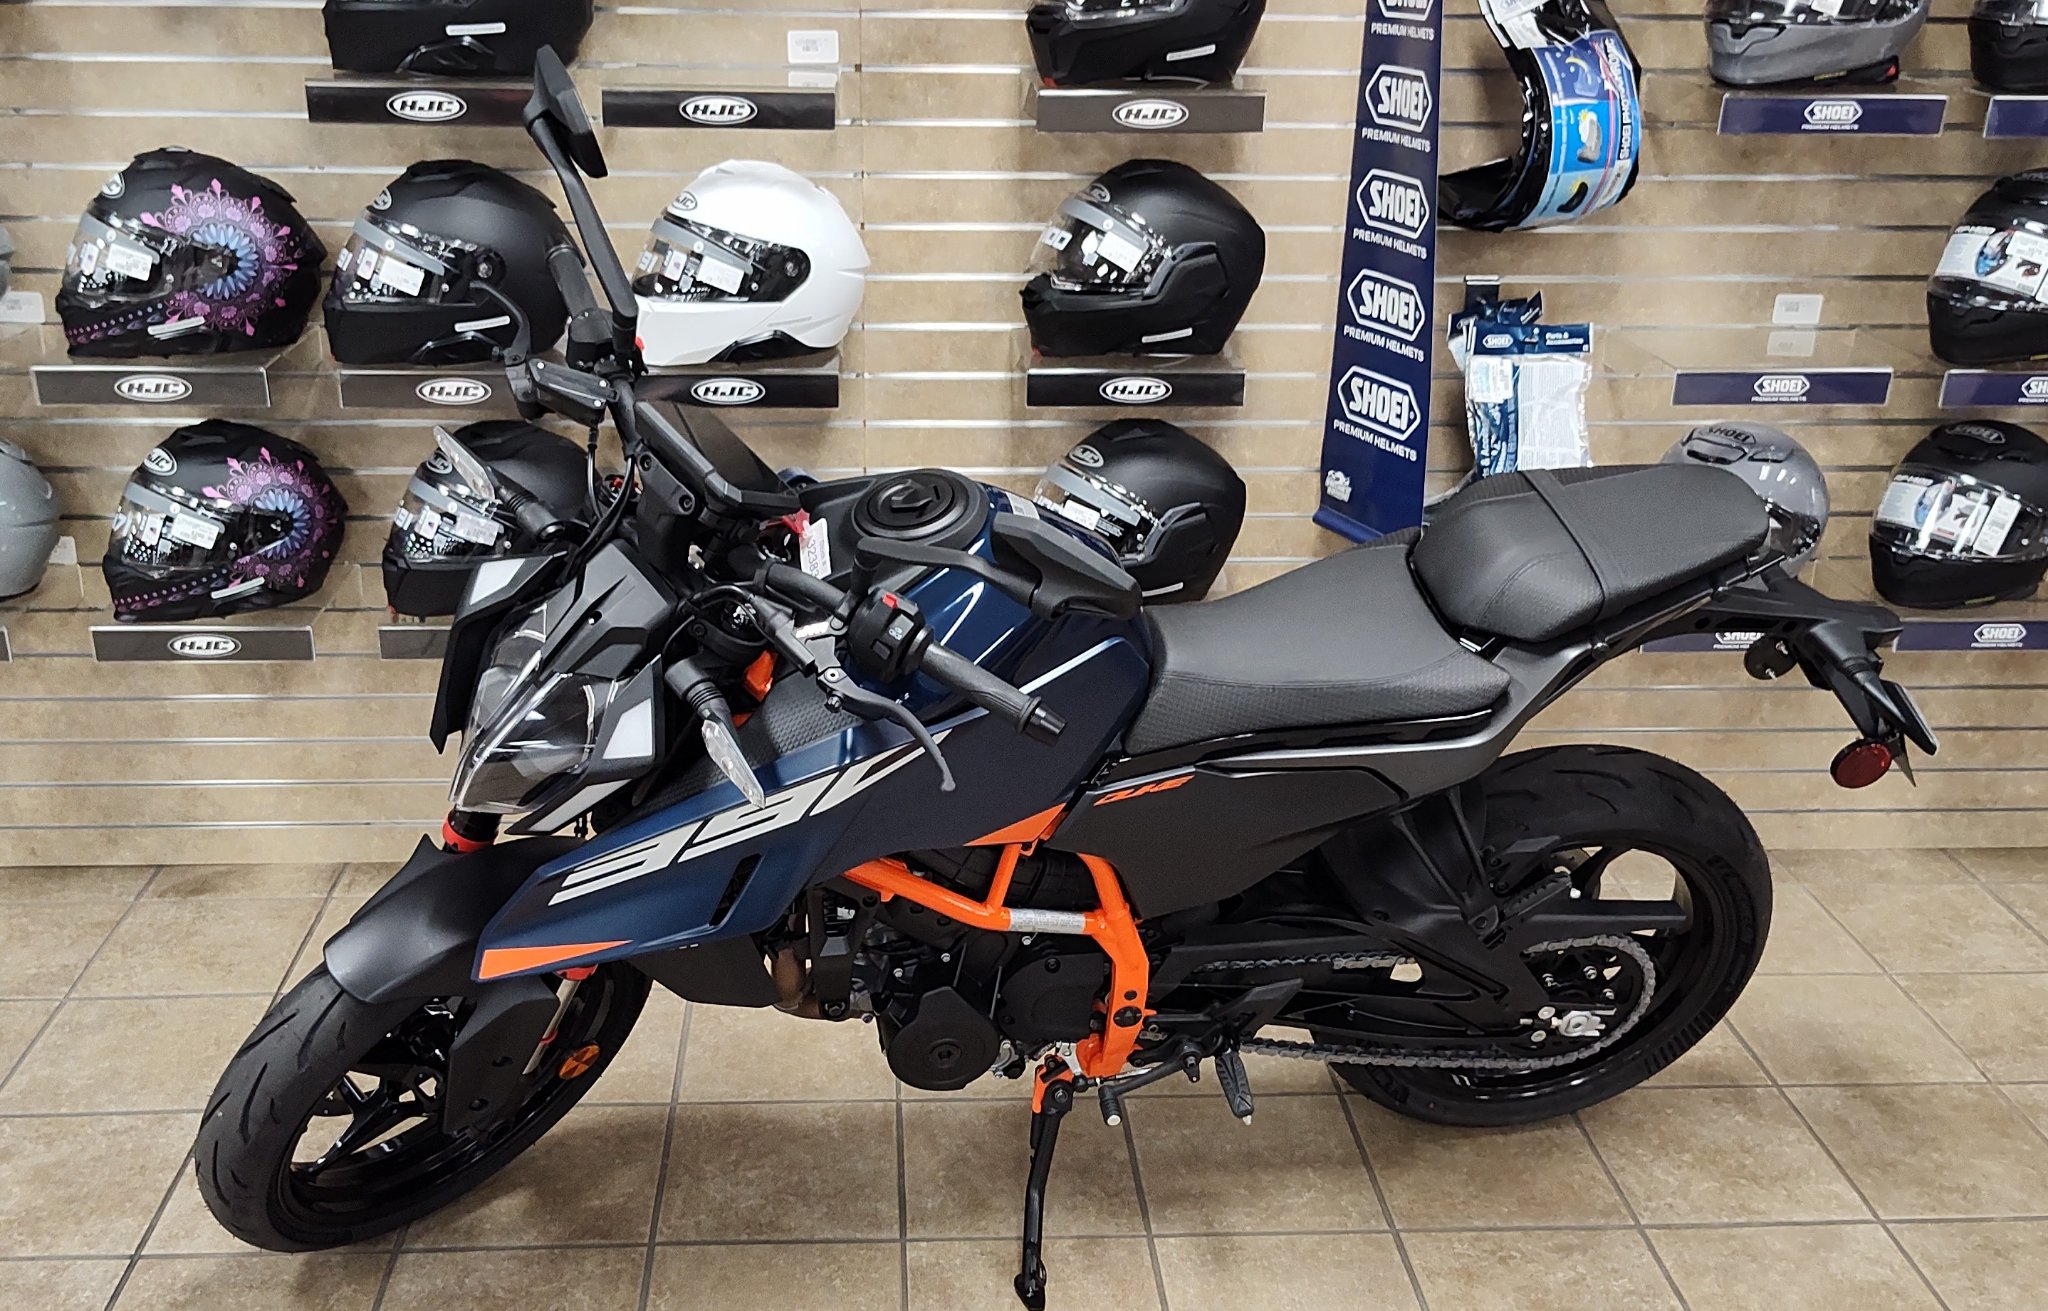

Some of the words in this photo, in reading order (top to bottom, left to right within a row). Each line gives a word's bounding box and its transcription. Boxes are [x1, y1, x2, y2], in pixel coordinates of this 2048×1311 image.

[1371, 22, 1407, 37] PREMIUM
[1377, 76, 1424, 121] SHOEI
[400, 100, 454, 112] HJC
[692, 104, 745, 116] HJC
[1812, 105, 1855, 120] SHOEI
[1124, 108, 1177, 120] HJC
[1361, 127, 1400, 144] PREMIUM
[1400, 134, 1431, 153] HELMETS
[1369, 180, 1420, 228] SHOEI
[1352, 227, 1393, 248] PREMIUM
[1393, 238, 1427, 260] HELMETS
[1359, 280, 1415, 331] SHOEI
[1343, 324, 1385, 348] PREMIUM
[1385, 338, 1424, 362] HELMETS
[1487, 337, 1509, 346] SHOEI
[127, 383, 180, 394] HJC
[428, 386, 479, 397] HJC
[703, 386, 754, 397] HJC
[1111, 385, 1161, 396] HJC
[1761, 379, 1803, 393] SHOEI
[1349, 376, 1409, 431] SHOEI
[1333, 418, 1374, 444] PREMIUM
[1374, 434, 1417, 462] HELMETS
[1981, 627, 2020, 639] SHOEI
[180, 641, 230, 650] HJC
